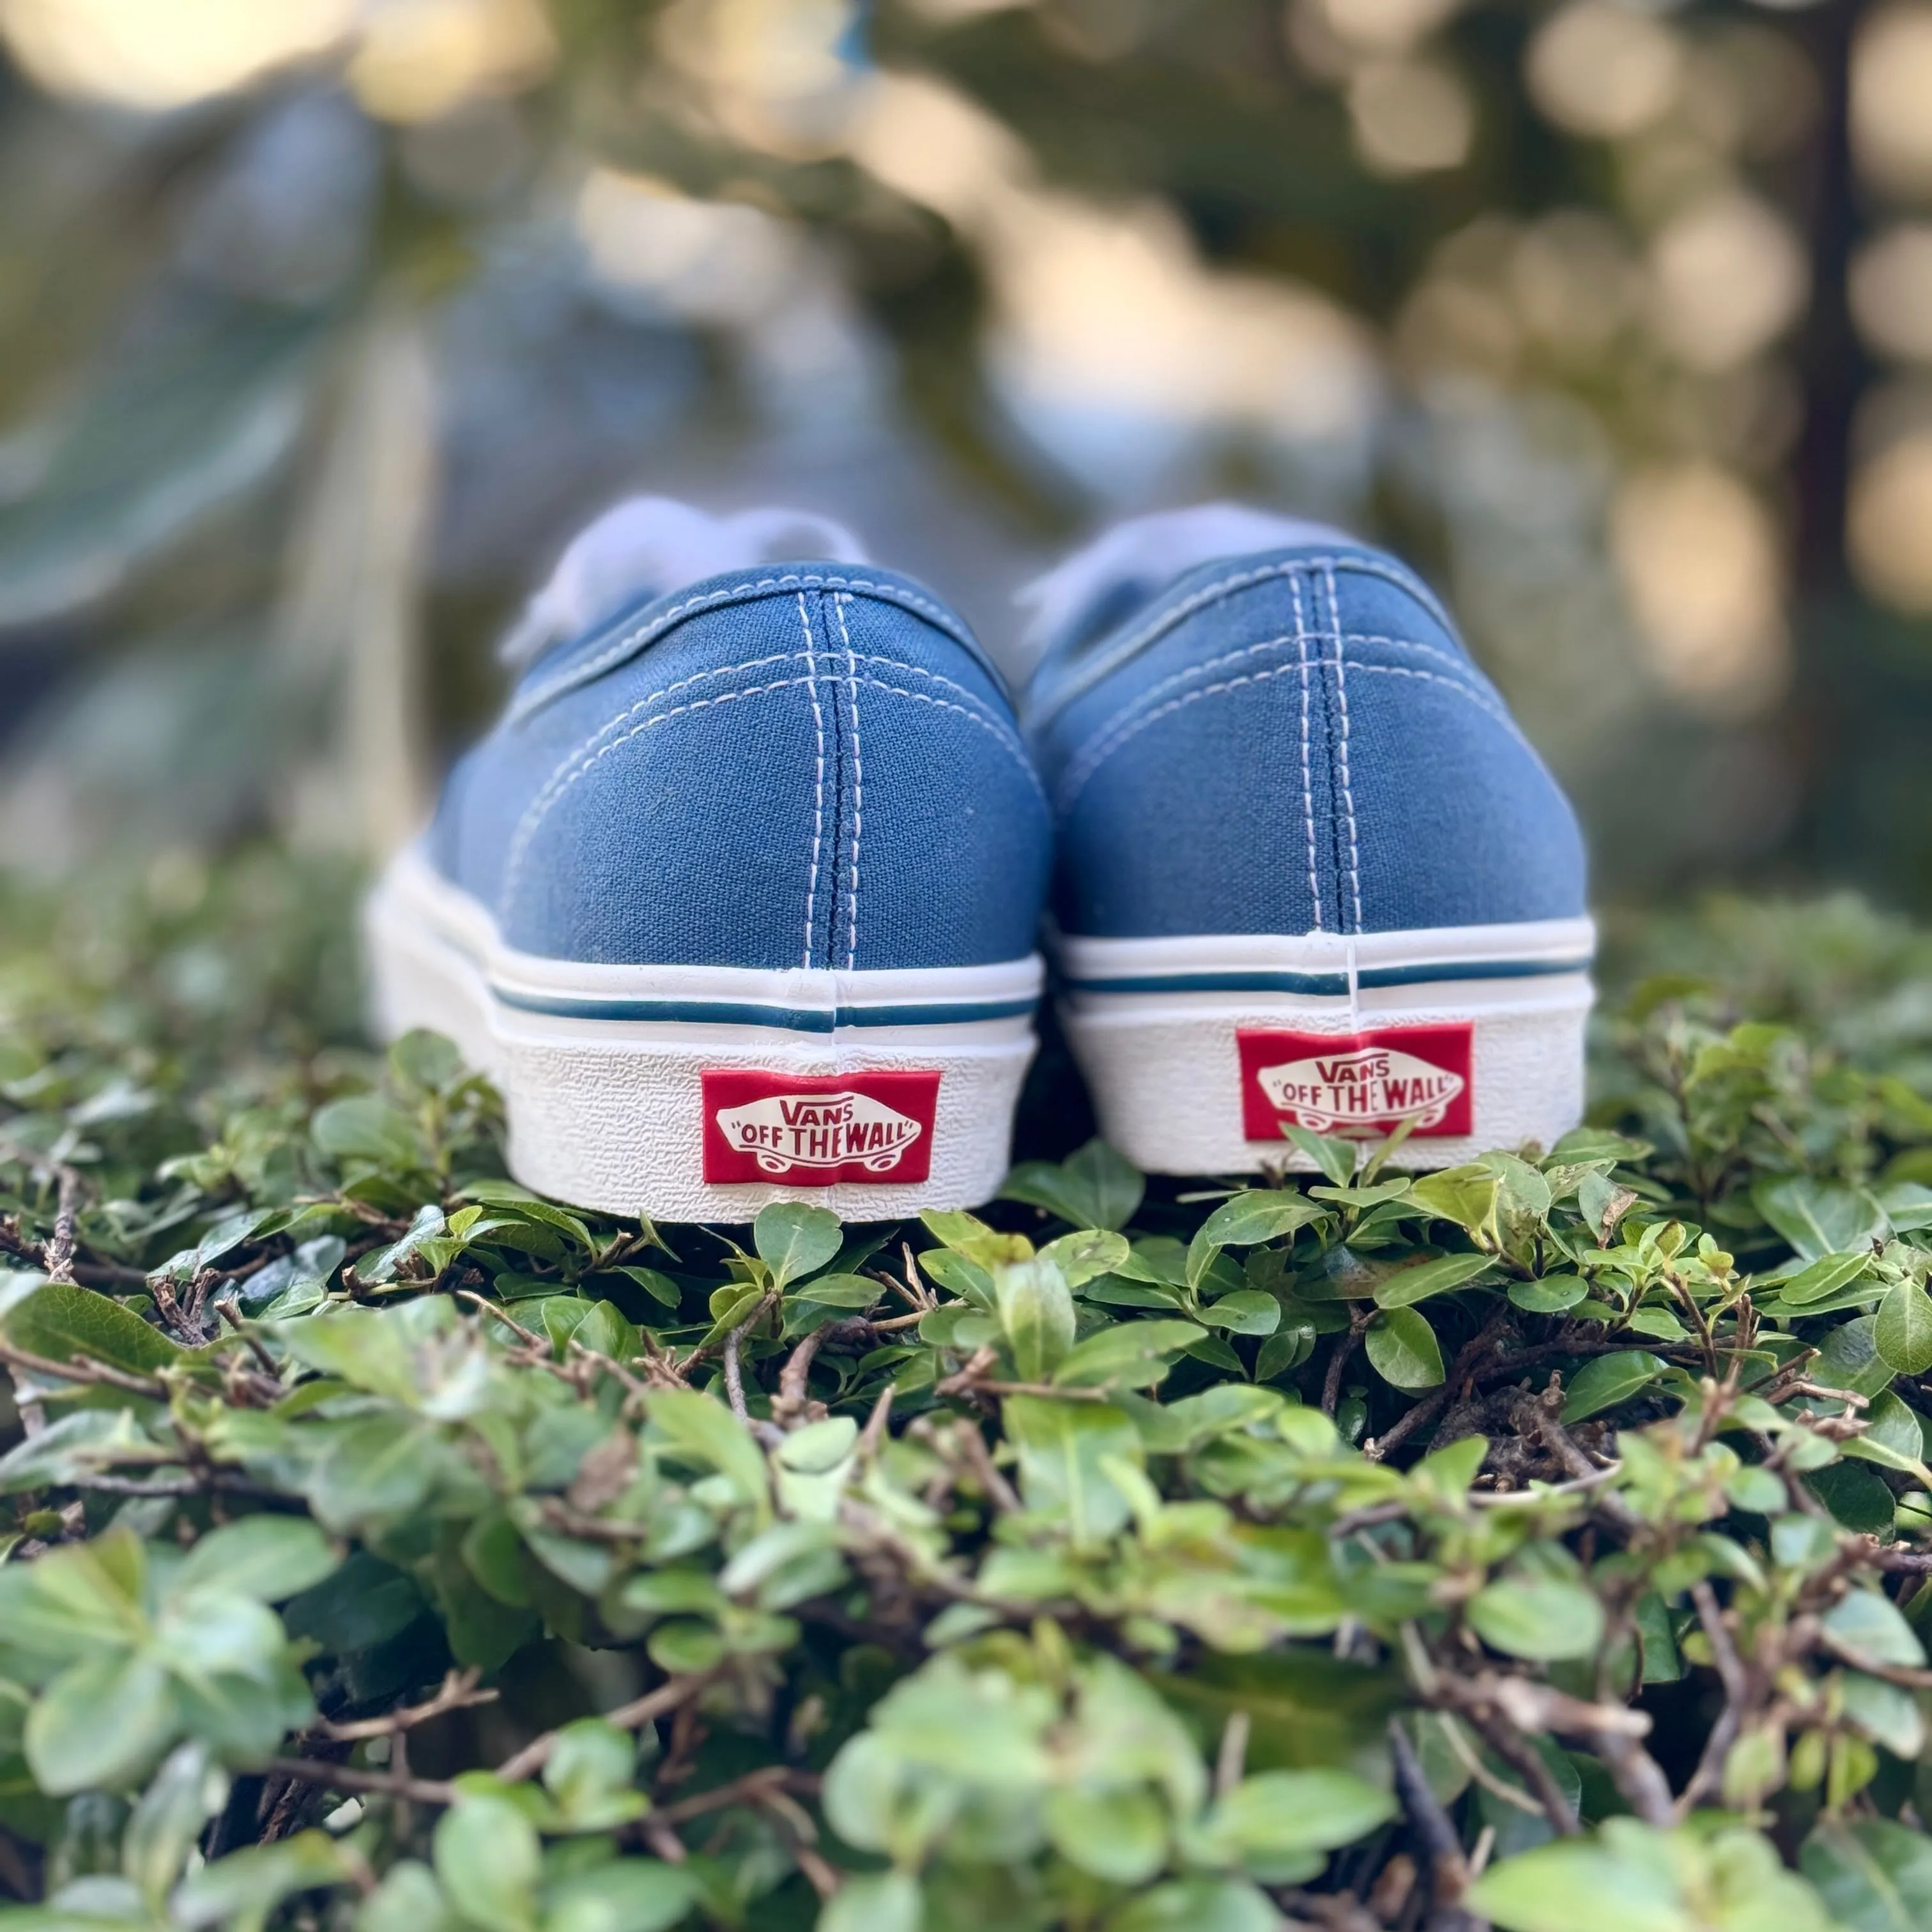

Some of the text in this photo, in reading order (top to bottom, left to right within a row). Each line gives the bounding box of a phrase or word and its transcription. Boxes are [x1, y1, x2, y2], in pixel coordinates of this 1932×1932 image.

[1315, 1053, 1390, 1083] VANS
[780, 1096, 854, 1126] VANS
[1327, 1080, 1379, 1112] THE
[789, 1126, 843, 1158] THE
